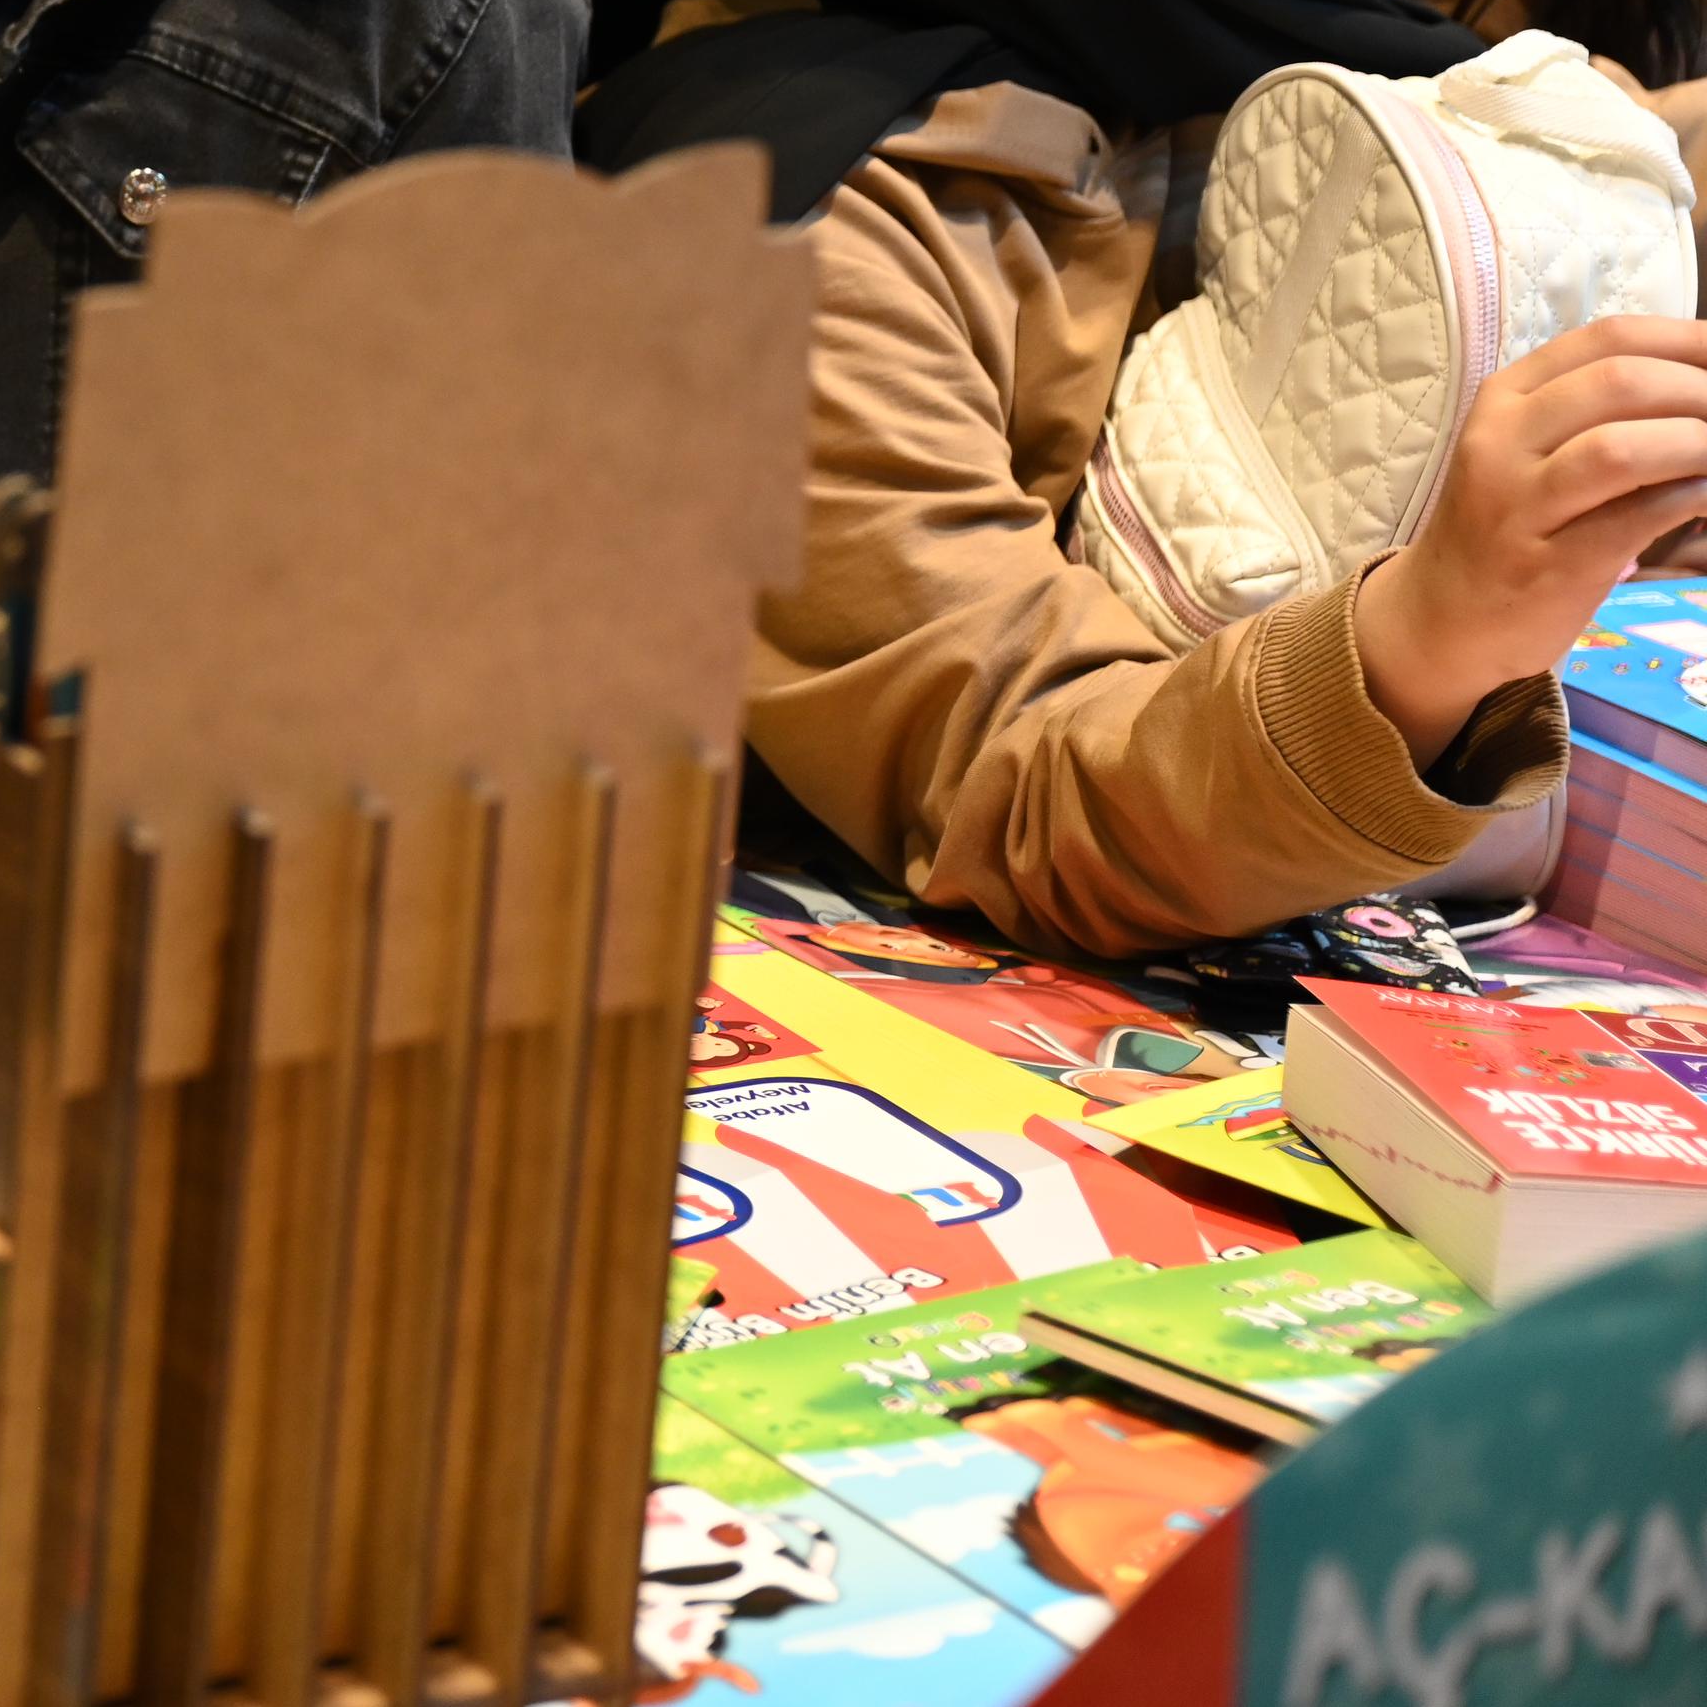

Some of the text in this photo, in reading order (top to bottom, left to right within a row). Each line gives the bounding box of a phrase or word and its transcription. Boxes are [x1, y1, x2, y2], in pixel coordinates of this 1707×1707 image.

[1371, 987, 1523, 1019] KARATAY
[713, 1100, 810, 1124] Alfabe
[1462, 1087, 1697, 1133] SÖZLÜK
[776, 1266, 945, 1323] Benim
[1288, 1280, 1420, 1313] Ben
[939, 1331, 1028, 1365] en
[843, 1351, 932, 1388] At
[1283, 1505, 1707, 1707] AÇ-KA
